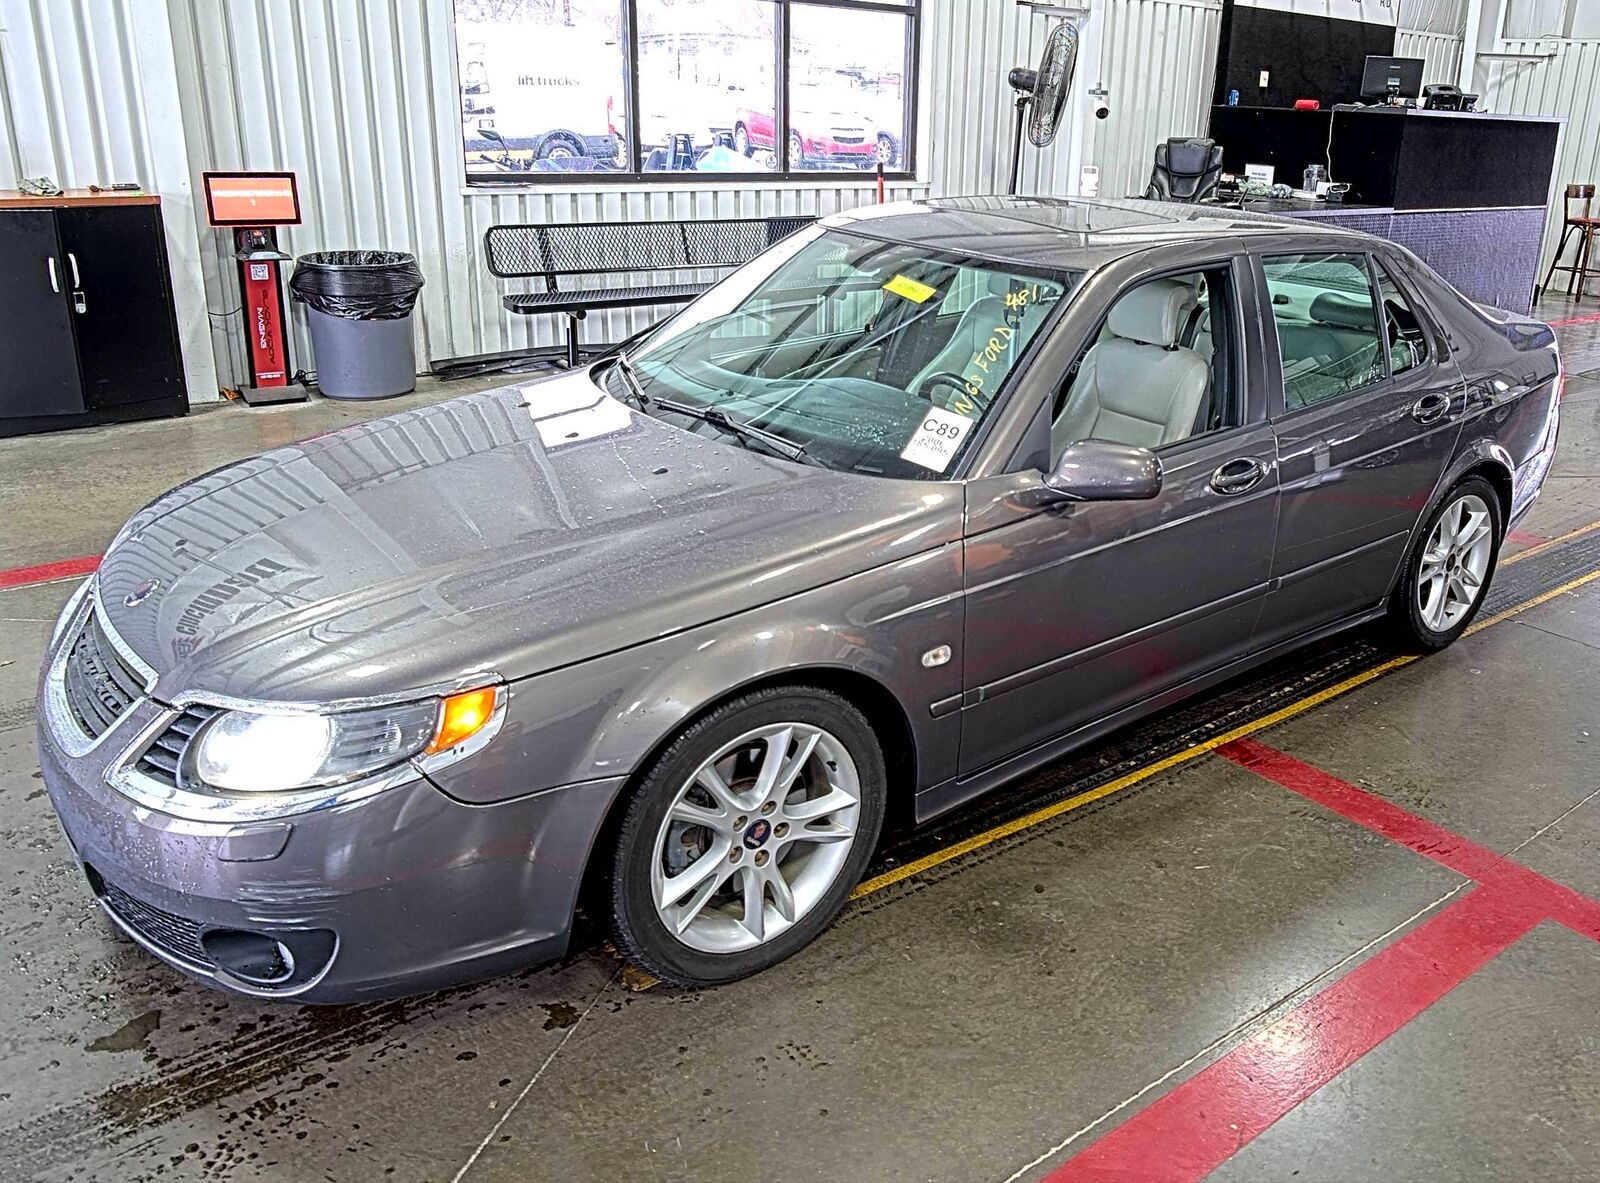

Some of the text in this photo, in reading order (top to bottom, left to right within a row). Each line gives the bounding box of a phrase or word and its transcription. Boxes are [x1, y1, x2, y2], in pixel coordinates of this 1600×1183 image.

[538, 75, 580, 86] trucks
[974, 327, 1012, 373] FORD
[923, 418, 960, 440] C89
